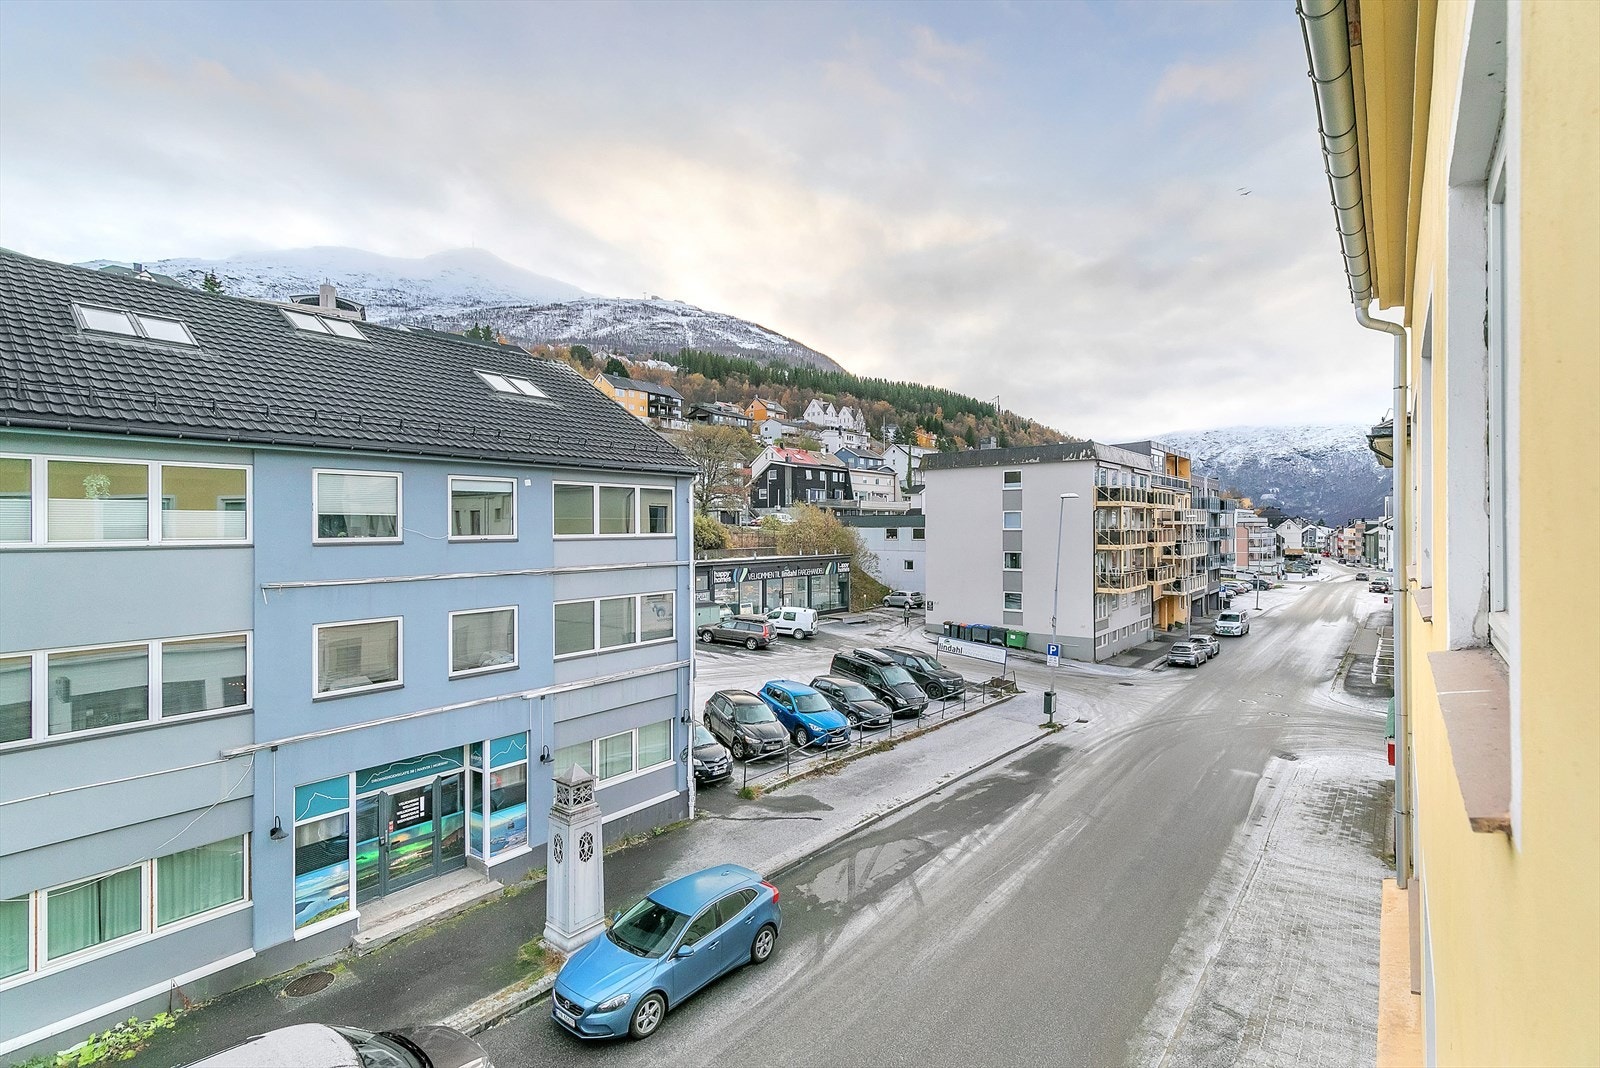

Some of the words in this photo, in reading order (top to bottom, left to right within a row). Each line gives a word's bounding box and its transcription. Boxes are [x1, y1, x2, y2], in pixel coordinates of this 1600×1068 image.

[714, 570, 732, 579] happy
[939, 643, 963, 654] lindahl
[1050, 645, 1057, 654] P
